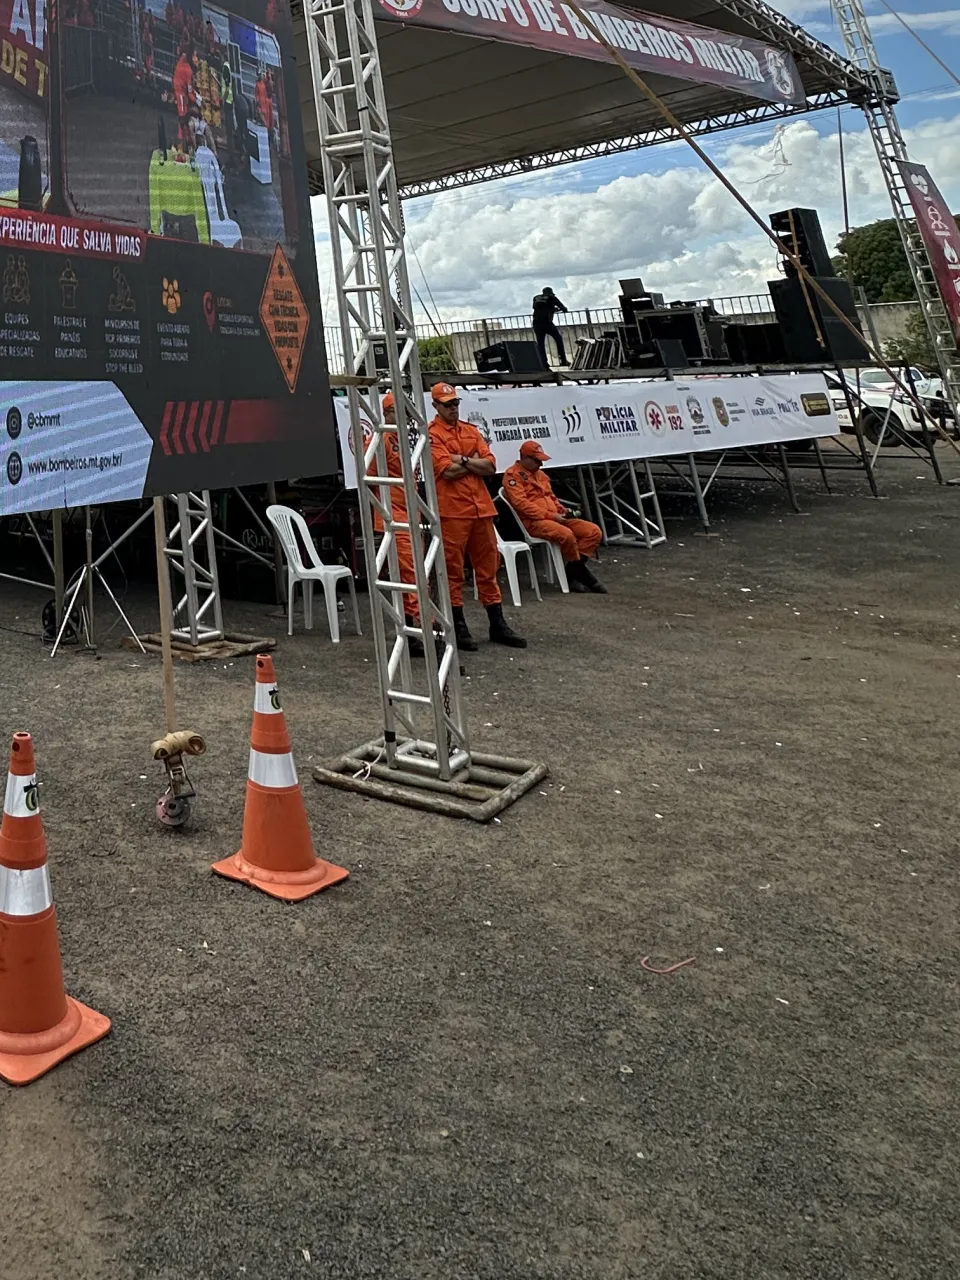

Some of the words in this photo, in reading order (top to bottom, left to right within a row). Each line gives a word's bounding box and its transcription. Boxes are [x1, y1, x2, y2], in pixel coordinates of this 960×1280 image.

[0, 38, 29, 87] DE
[686, 35, 765, 83] MILITAR
[60, 227, 79, 248] QUE
[83, 229, 112, 253] SALVA
[115, 233, 141, 257] VIDAS
[4, 312, 30, 325] EQUIPES
[27, 412, 61, 429] @cbmmt
[600, 420, 638, 434] MILITAR
[668, 416, 684, 430] 192
[494, 426, 522, 442] TANGARÁ
[523, 427, 531, 439] DA
[532, 427, 551, 439] SERRA
